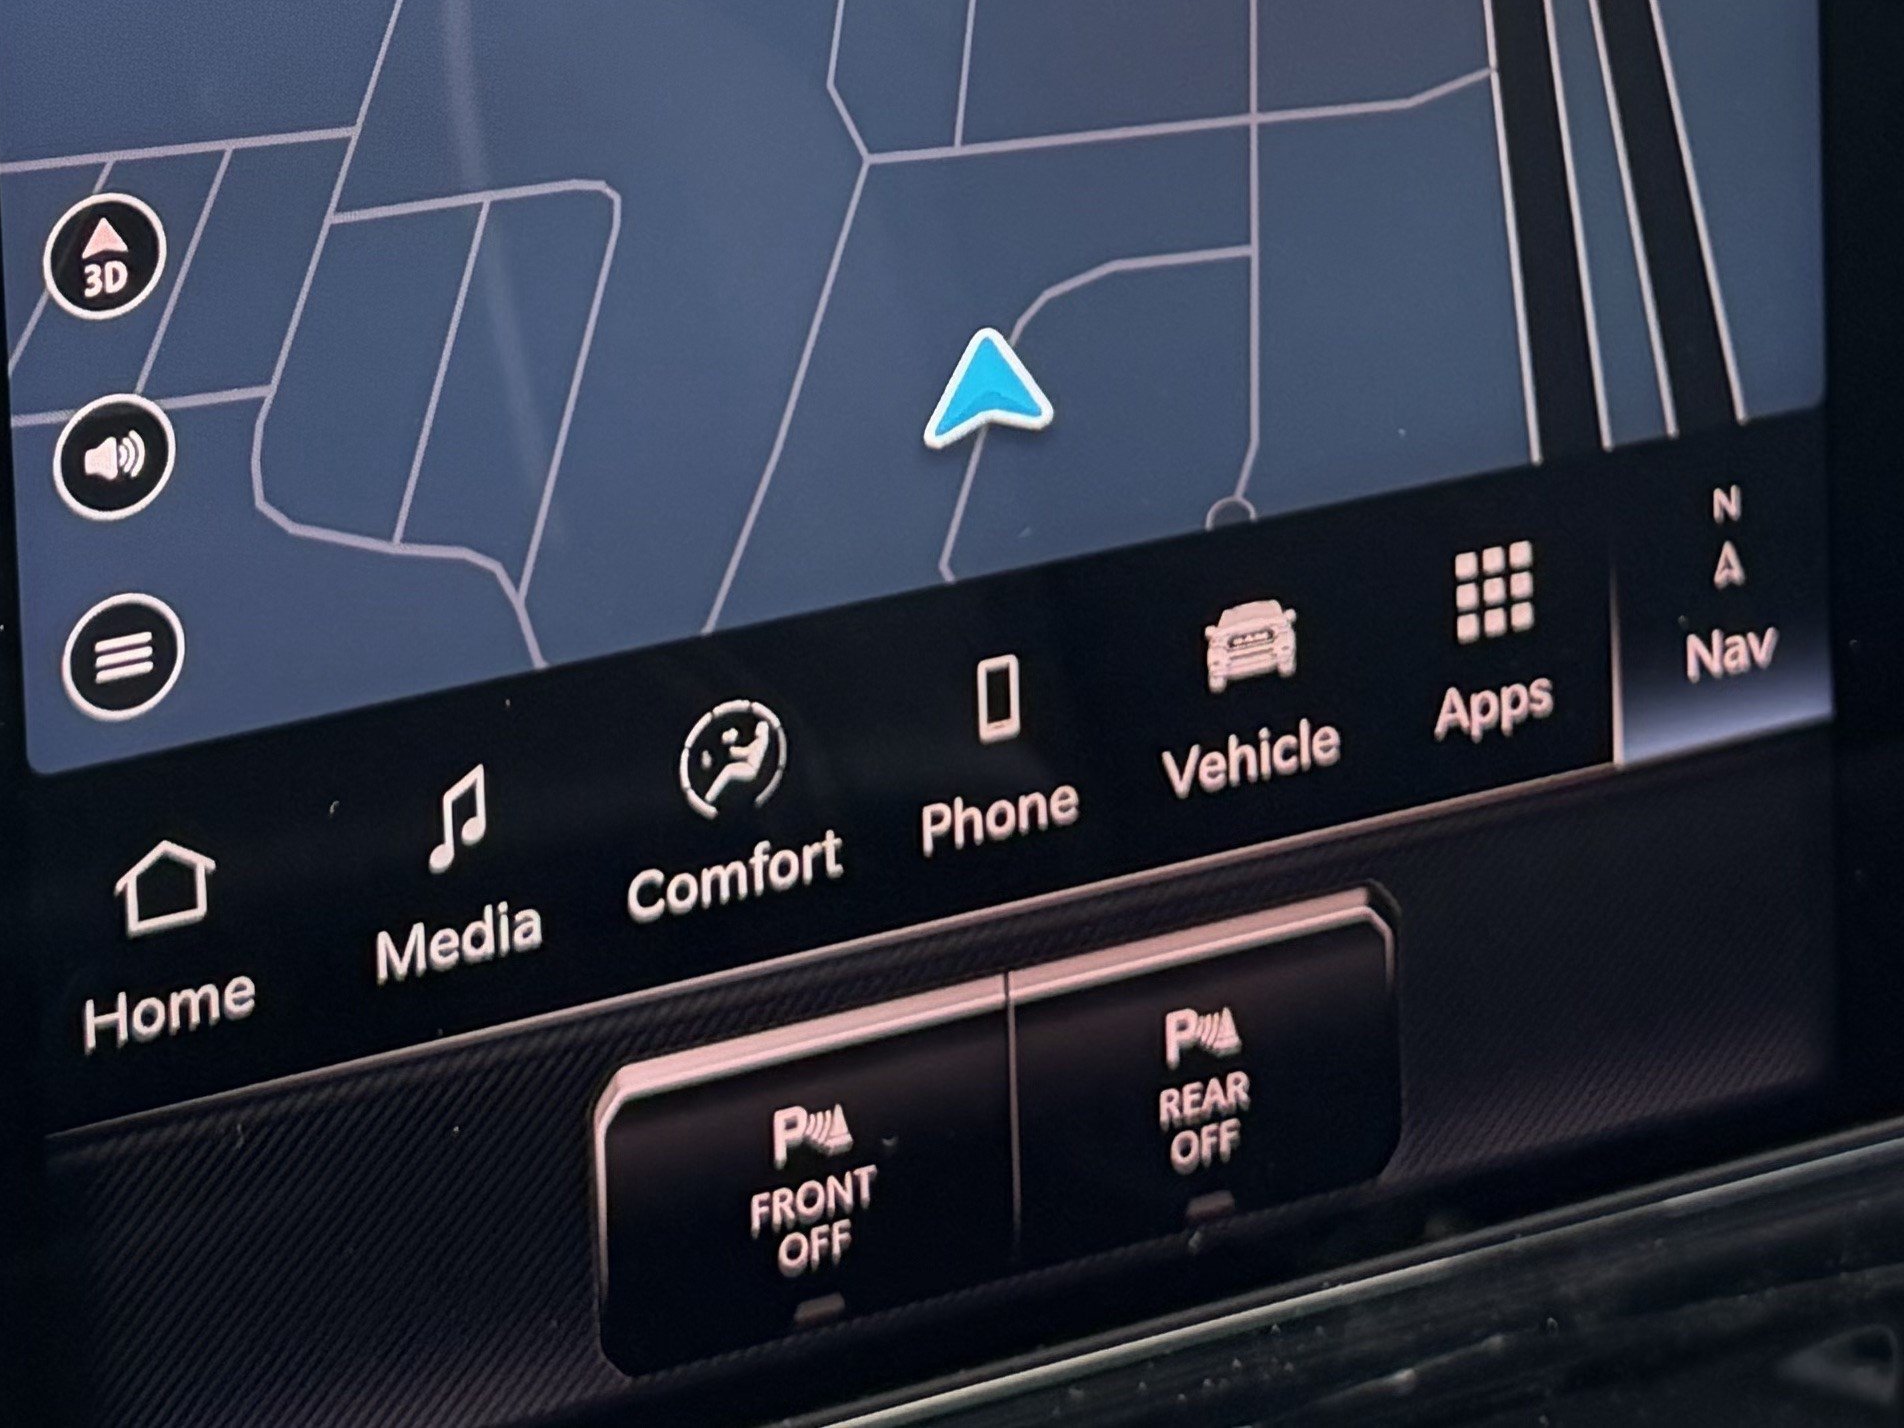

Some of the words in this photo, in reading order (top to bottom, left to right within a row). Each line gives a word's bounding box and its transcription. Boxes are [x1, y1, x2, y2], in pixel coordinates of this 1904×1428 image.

[84, 261, 128, 299] 3D
[1713, 486, 1742, 523] N
[1686, 627, 1780, 682] Nav
[1434, 676, 1554, 741] Apps
[1163, 717, 1341, 799] Vehicle
[921, 782, 1080, 857] Phone
[627, 830, 844, 924] Comfort
[376, 903, 544, 985] Media
[84, 974, 257, 1055] Home
[1159, 1072, 1250, 1129] REAR
[1170, 1120, 1240, 1176] OFF
[751, 1165, 876, 1237] FRONT
[778, 1222, 852, 1277] OFF
